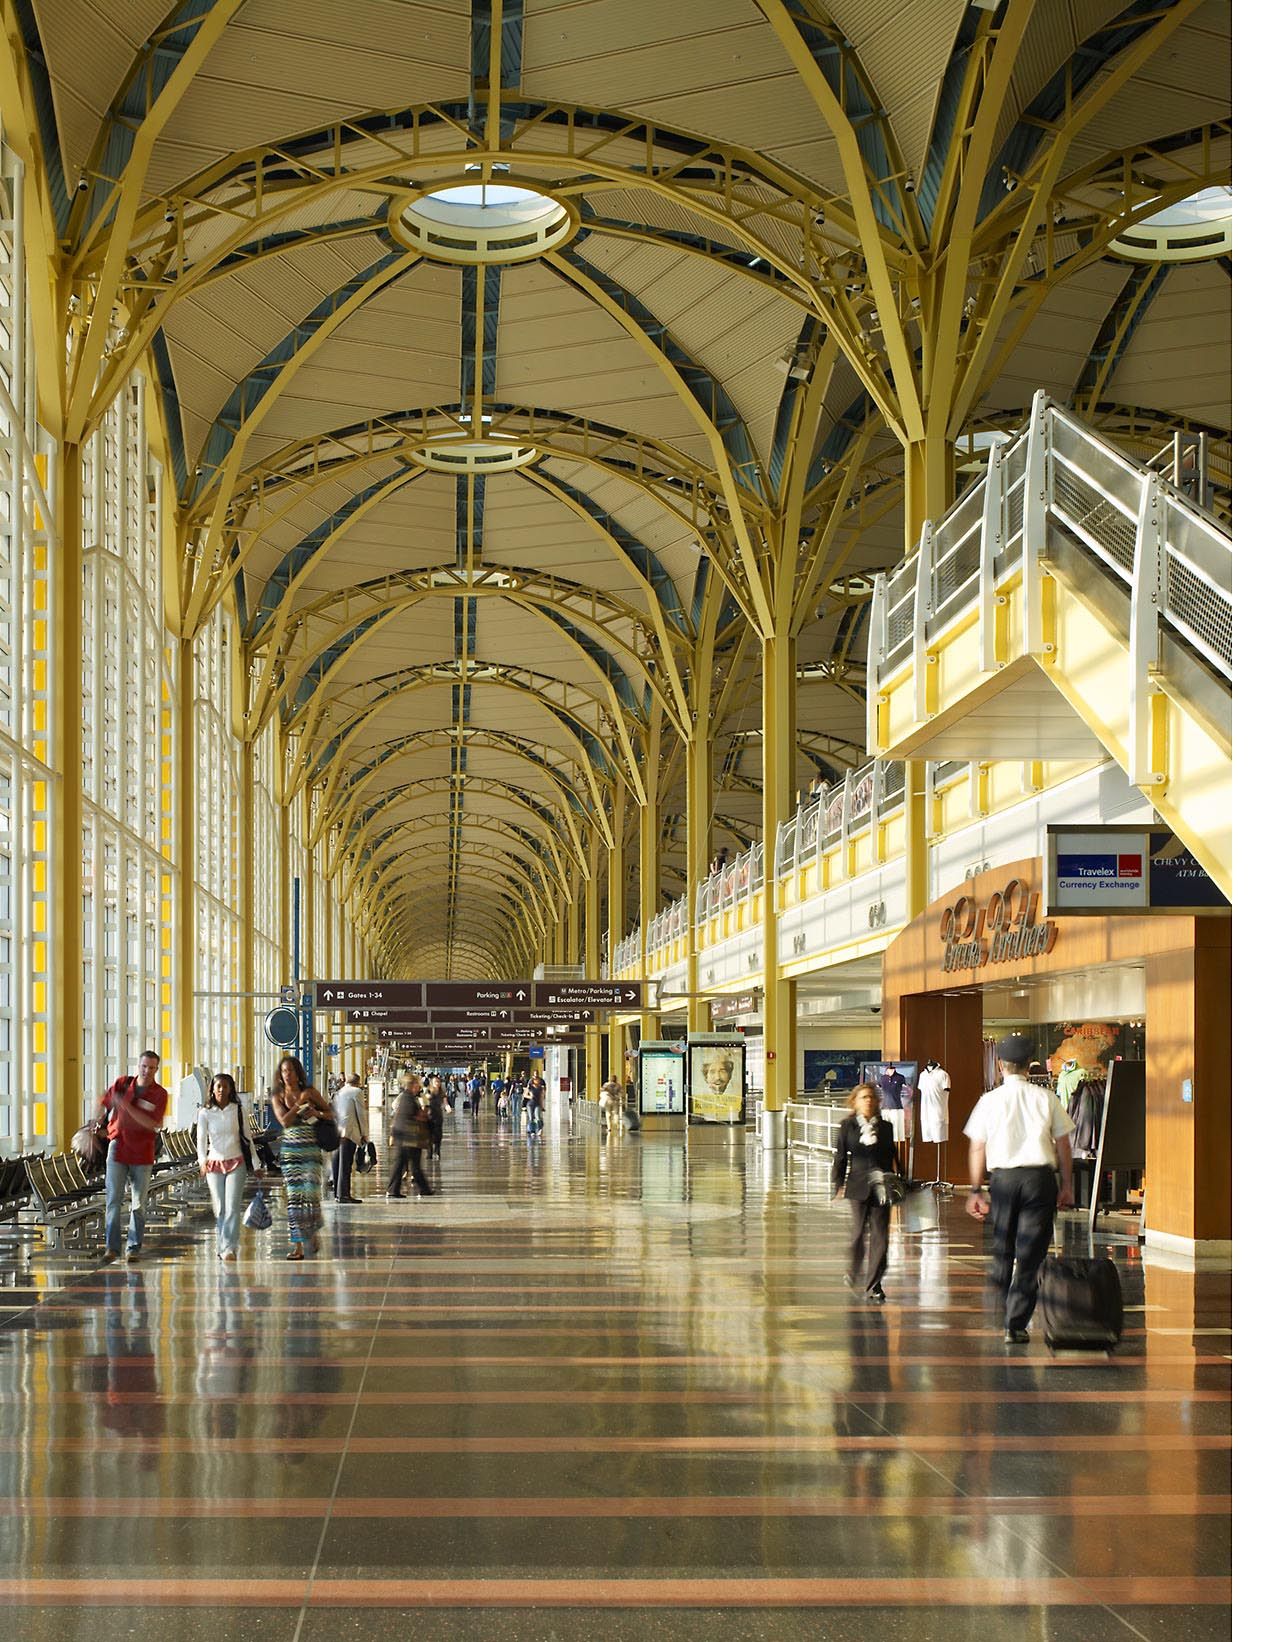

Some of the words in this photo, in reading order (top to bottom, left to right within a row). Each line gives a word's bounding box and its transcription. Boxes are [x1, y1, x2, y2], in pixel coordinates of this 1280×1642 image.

[1154, 857, 1186, 866] CHEVY
[1078, 867, 1115, 876] Travelex
[1176, 869, 1197, 877] ATM
[1059, 881, 1097, 890] Currency
[1099, 881, 1140, 890] Exchange
[476, 991, 500, 999] Parking
[568, 987, 613, 995] Metro/Parking
